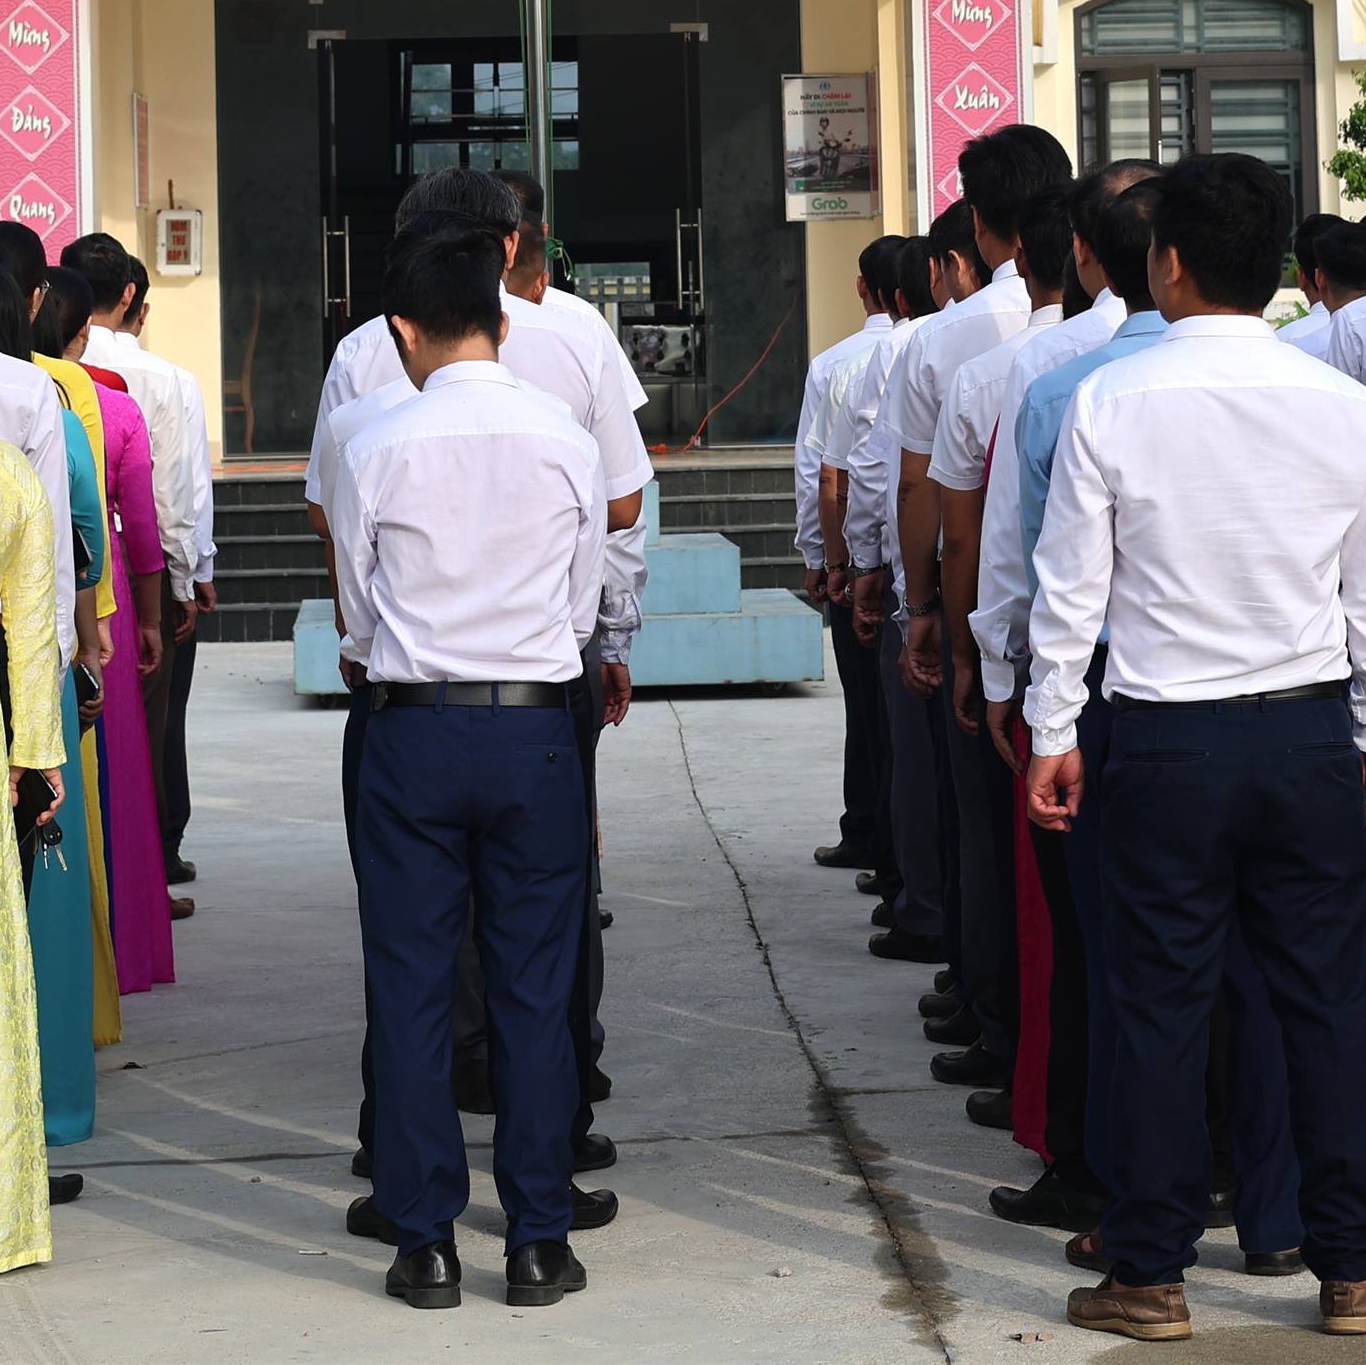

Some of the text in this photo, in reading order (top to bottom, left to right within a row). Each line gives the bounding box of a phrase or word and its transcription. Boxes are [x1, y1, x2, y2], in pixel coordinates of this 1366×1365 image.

[955, 84, 1000, 110] Xuân
[11, 104, 52, 139] Đảng
[10, 194, 55, 225] Quang
[811, 197, 848, 211] Grab
